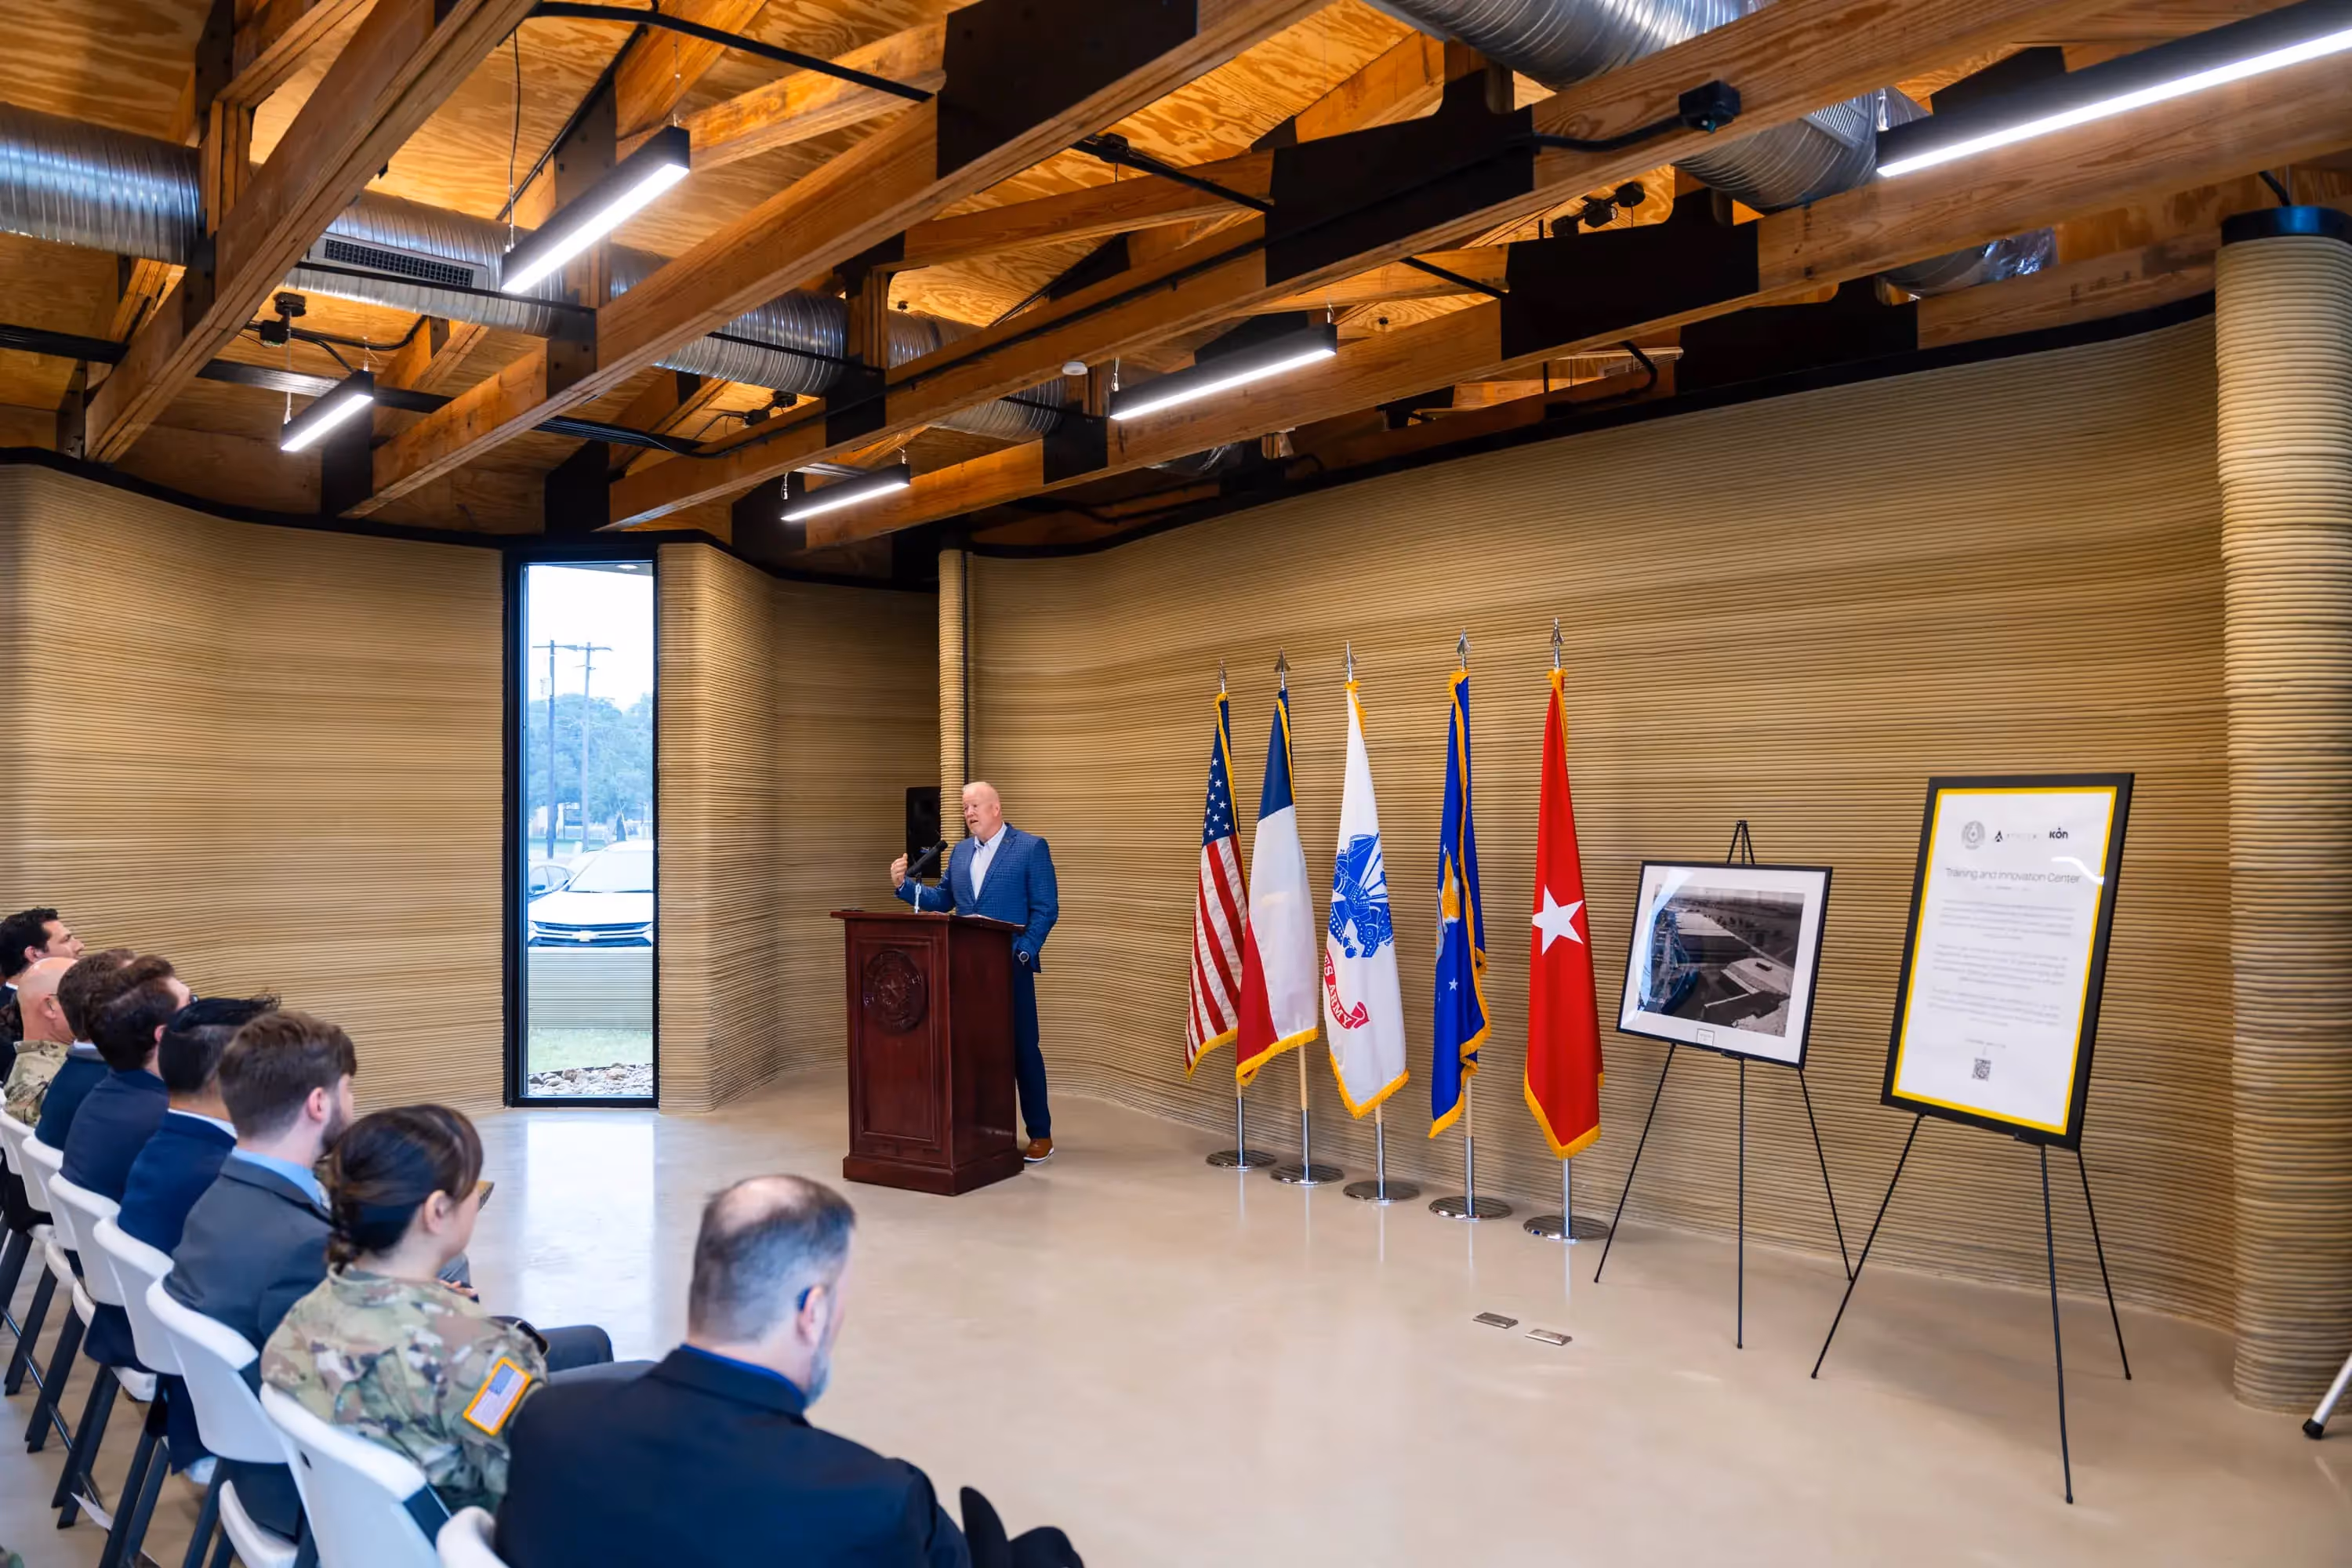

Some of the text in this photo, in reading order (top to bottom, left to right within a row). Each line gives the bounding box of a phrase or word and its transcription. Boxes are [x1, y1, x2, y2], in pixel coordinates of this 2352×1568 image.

[1946, 867, 2081, 884] Training and Innovation Center
[1329, 984, 1352, 1027] ARMY
